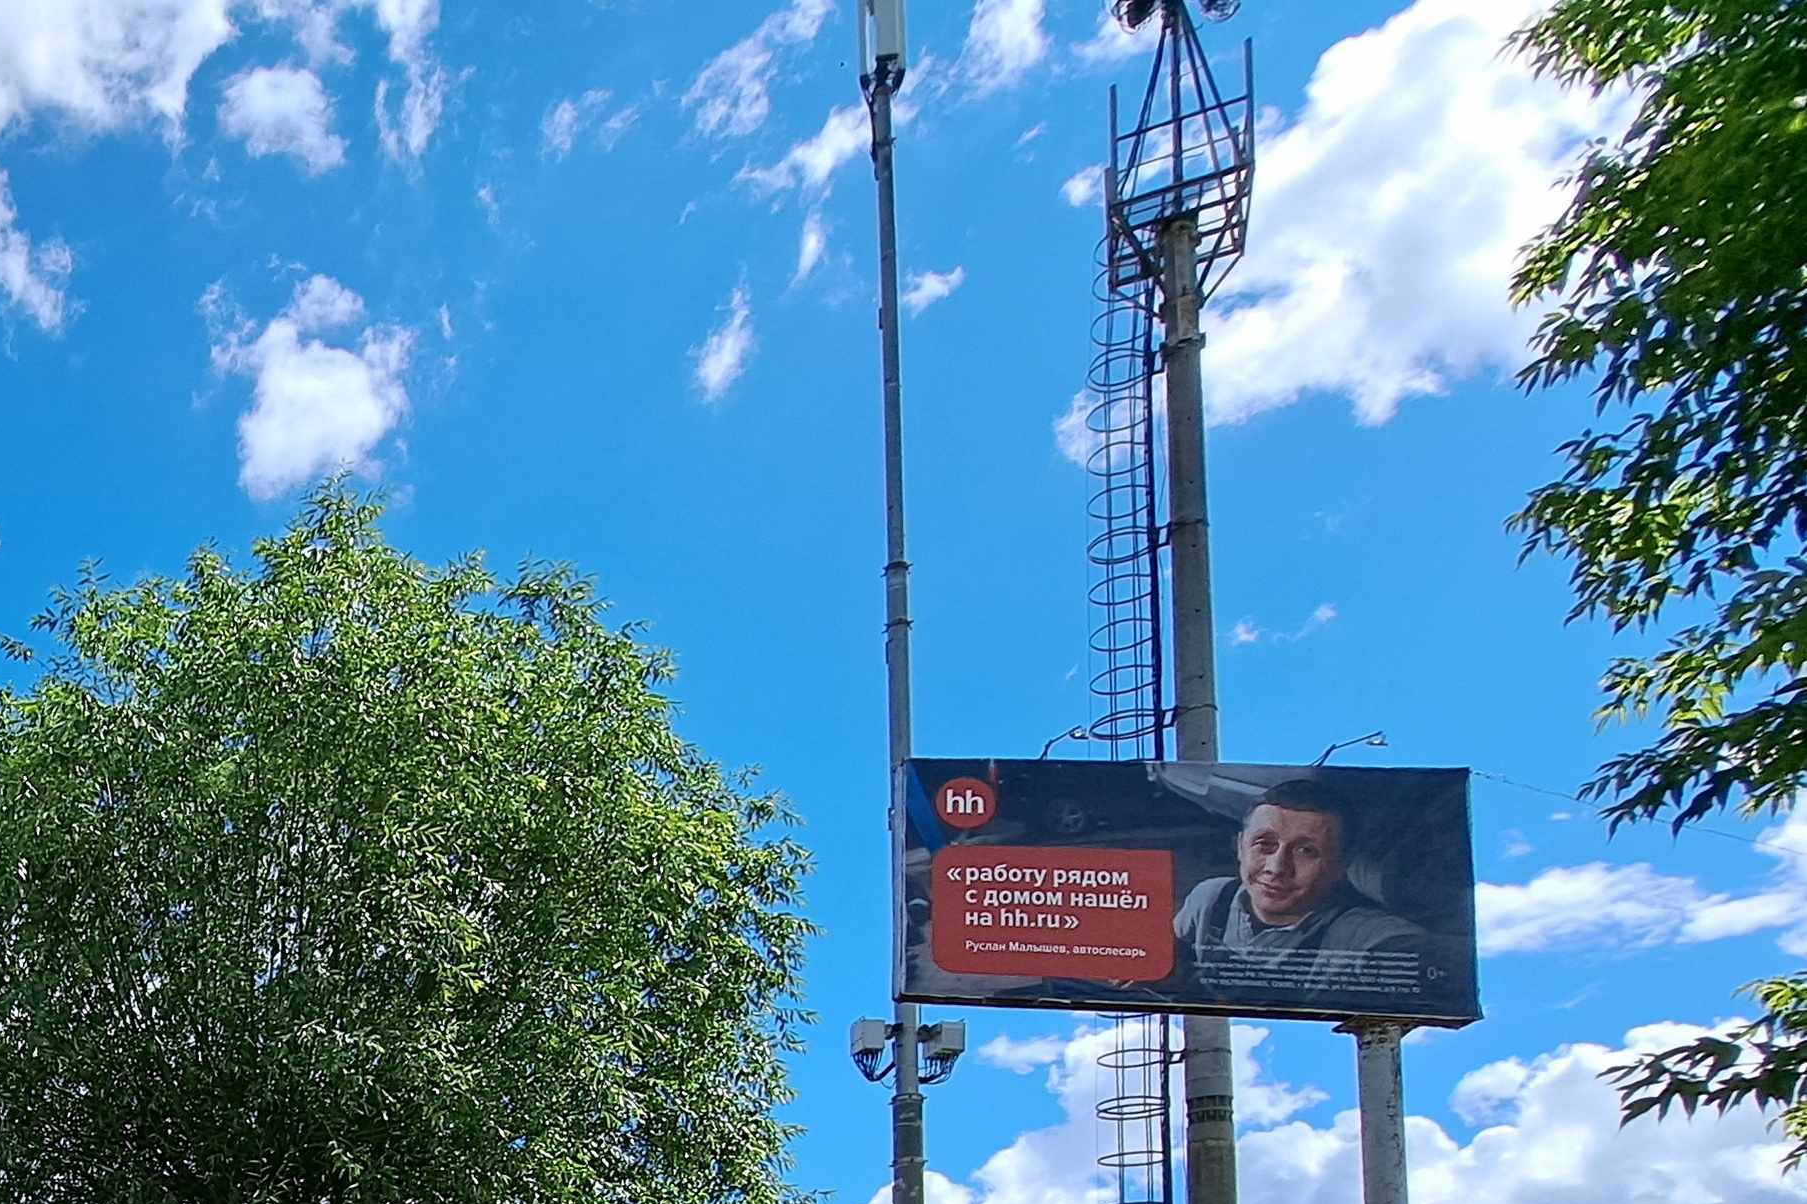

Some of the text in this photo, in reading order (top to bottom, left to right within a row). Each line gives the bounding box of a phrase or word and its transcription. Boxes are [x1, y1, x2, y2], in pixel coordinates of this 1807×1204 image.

[946, 789, 984, 814] hh
[1053, 868, 1129, 888] рядом
[965, 889, 1148, 910] с домом нашёл
[965, 911, 993, 927] на
[965, 940, 1146, 959] Руслан Малышев, автослесарь
